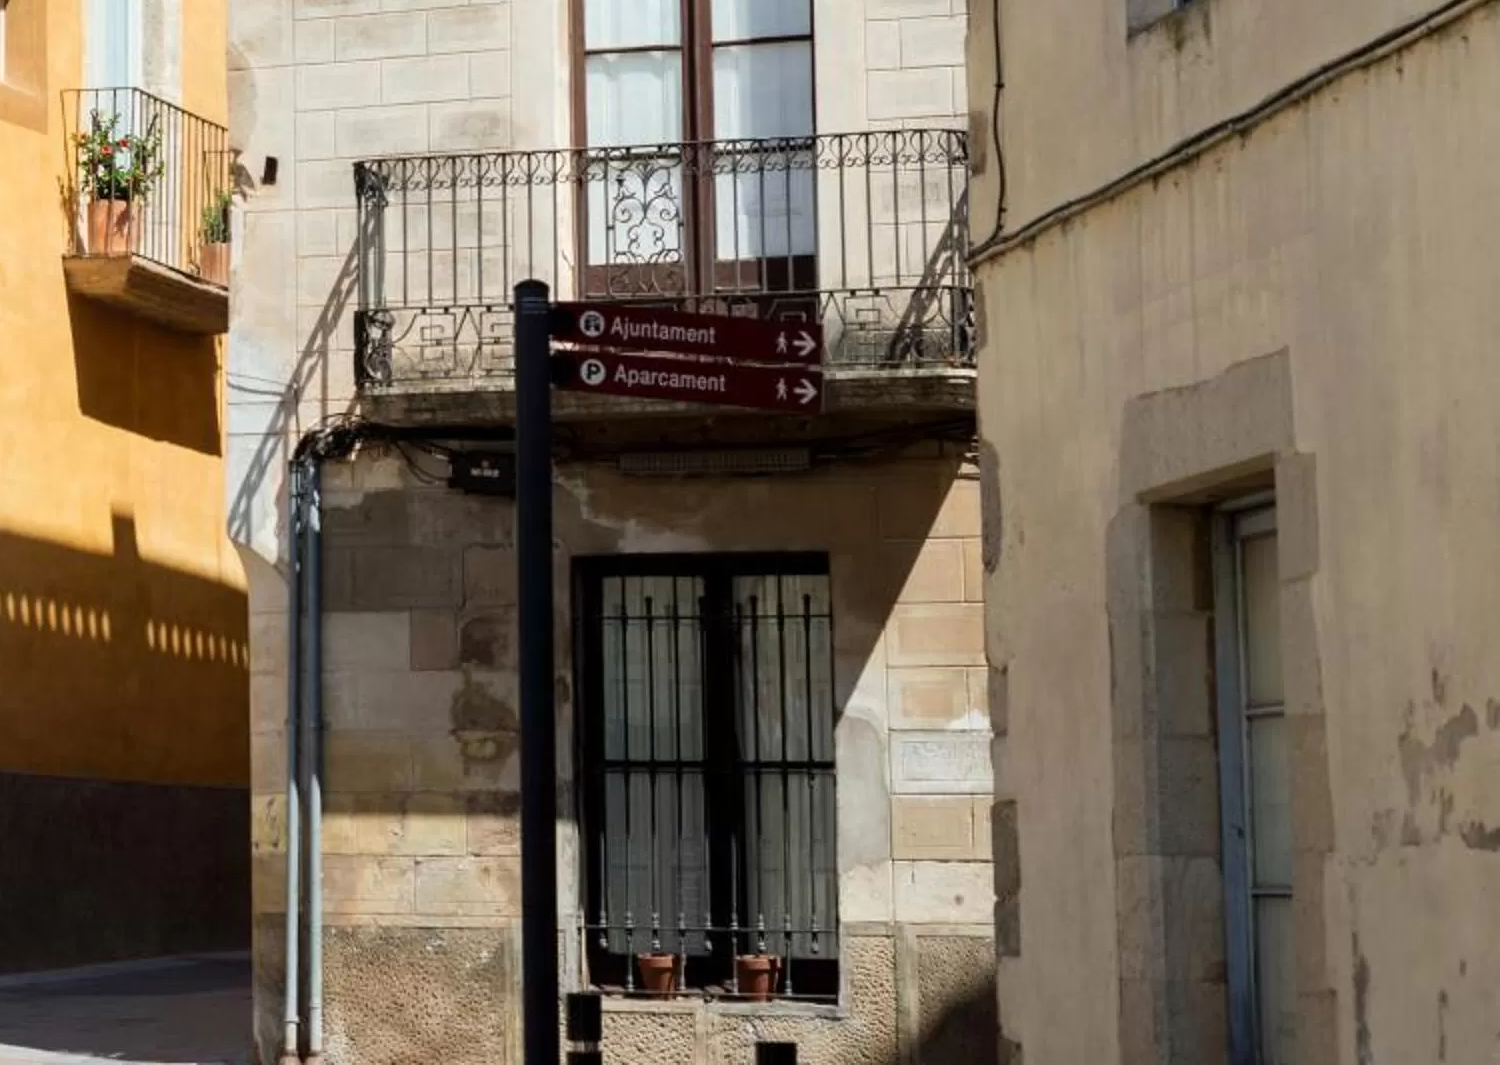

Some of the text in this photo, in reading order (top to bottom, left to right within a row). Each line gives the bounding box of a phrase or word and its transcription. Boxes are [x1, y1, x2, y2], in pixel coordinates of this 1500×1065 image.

[611, 316, 716, 344] Ajuntament
[587, 363, 726, 392] P Aparcament
